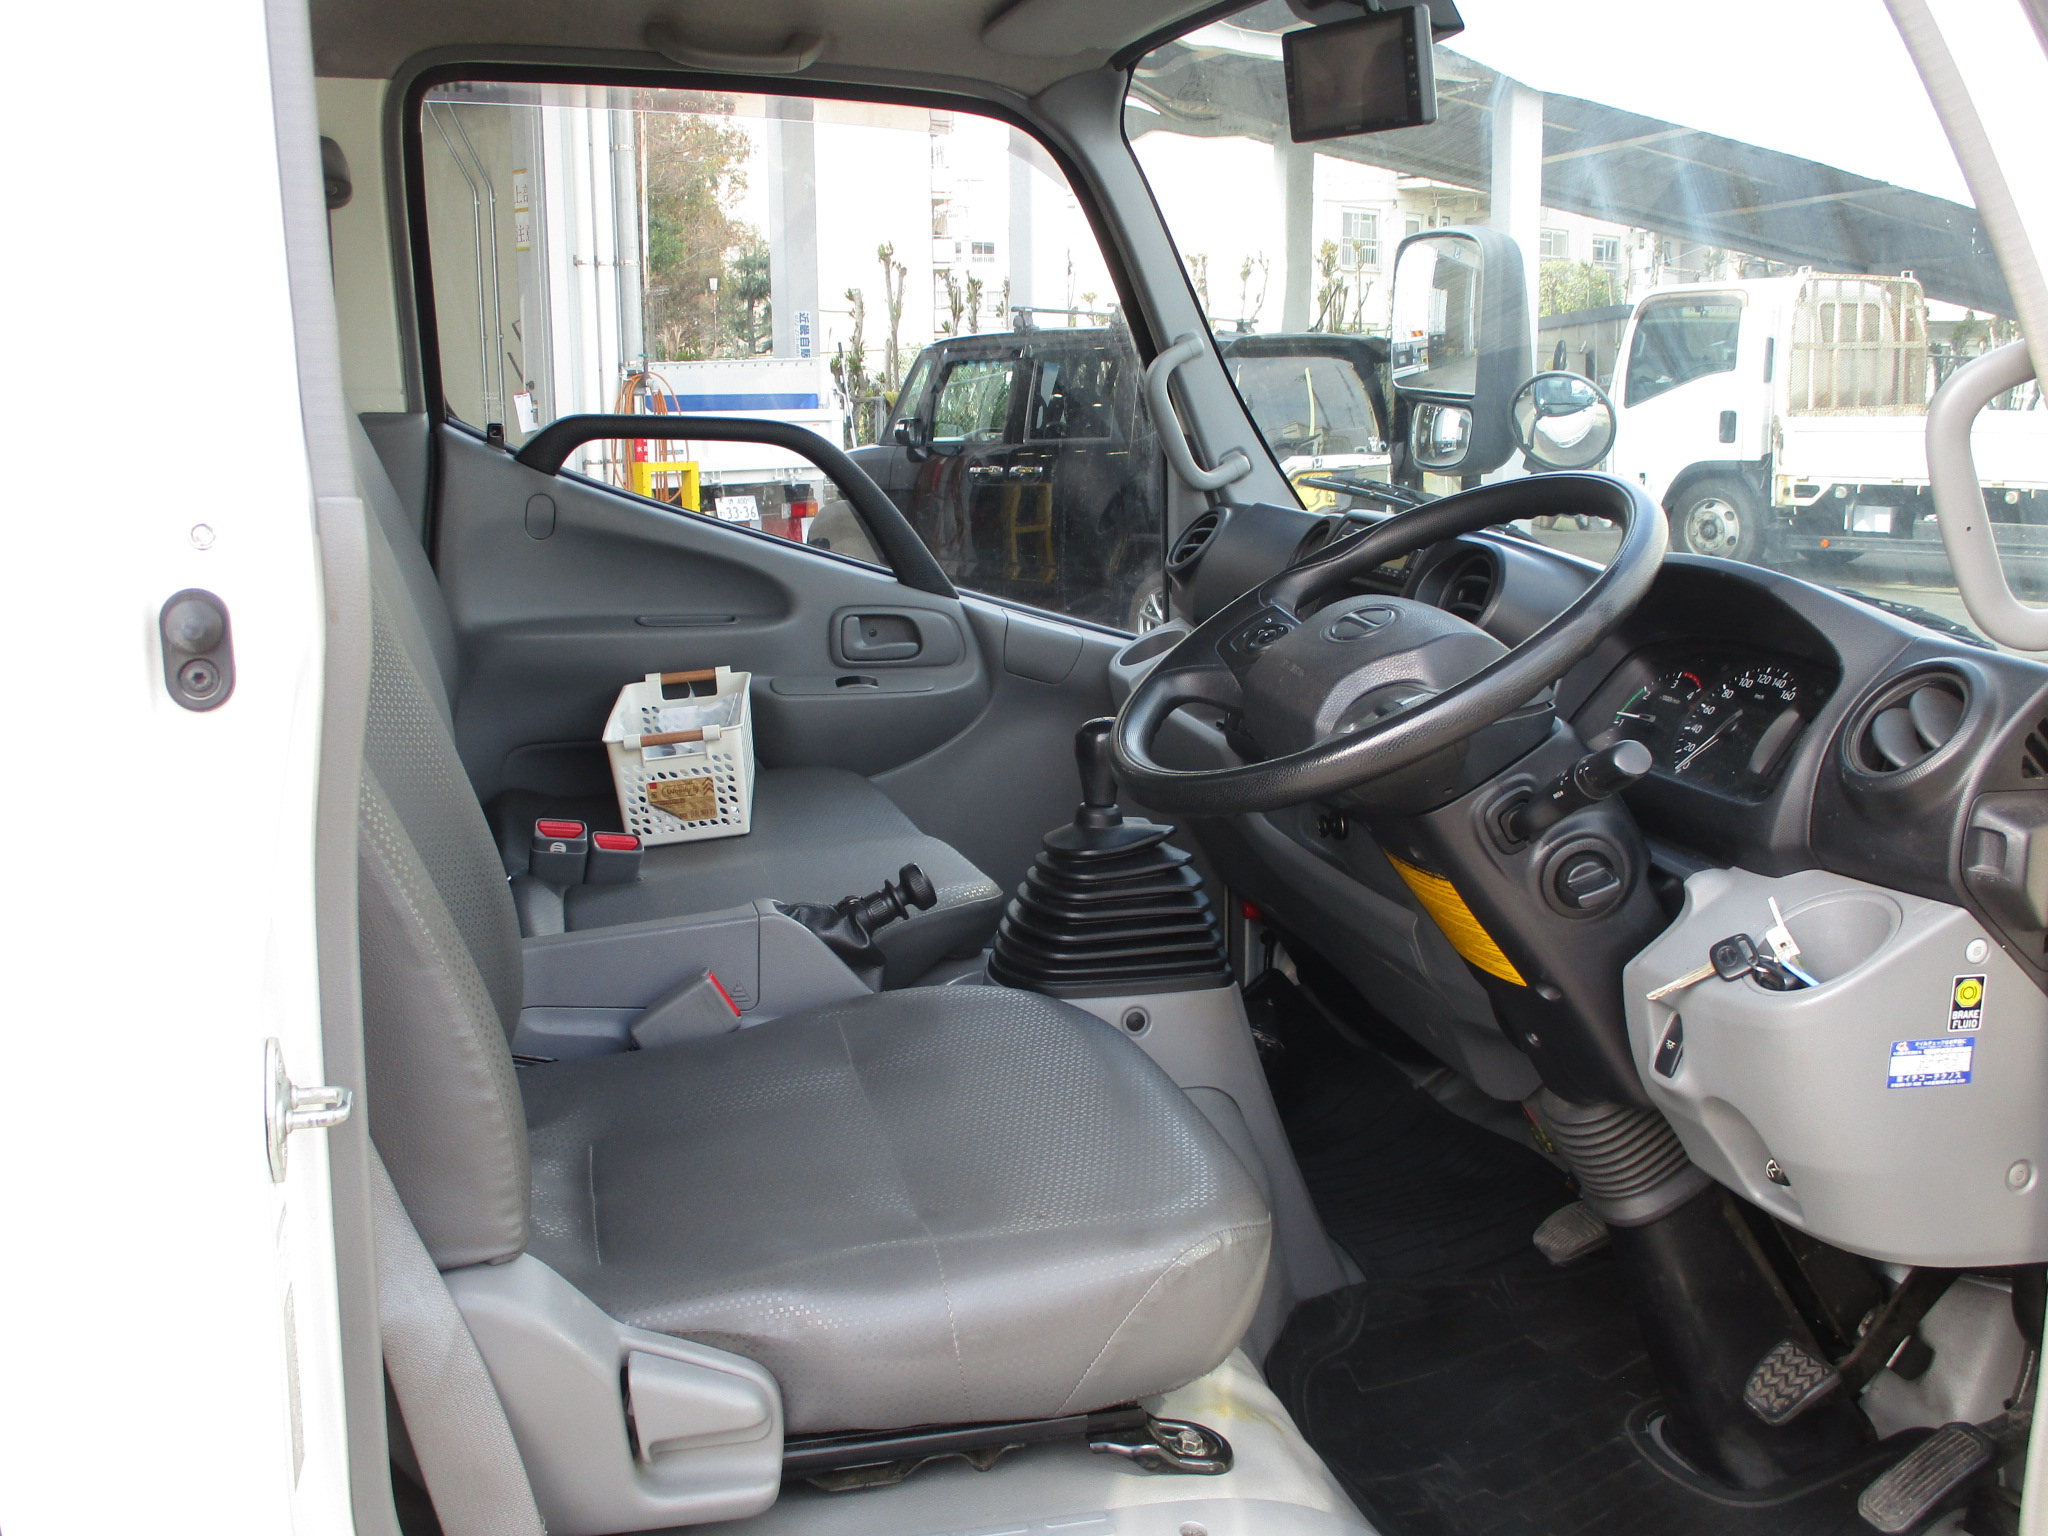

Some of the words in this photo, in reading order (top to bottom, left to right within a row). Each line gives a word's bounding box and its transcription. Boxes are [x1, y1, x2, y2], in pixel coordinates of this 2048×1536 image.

[726, 505, 757, 519] 33-36
[1670, 679, 1679, 689] 3
[1739, 677, 1754, 688] 100
[1757, 674, 1772, 685] 120
[1771, 678, 1787, 689] 140
[1643, 691, 1651, 700] 2
[1687, 691, 1695, 701] 4
[1721, 689, 1734, 699] 80
[1780, 690, 1796, 701] 160
[1703, 706, 1716, 715] 60
[1618, 718, 1625, 727] 1
[1691, 723, 1703, 734] 40
[1683, 742, 1696, 752] 20
[1952, 1010, 1980, 1019] BRAKE
[1952, 1019, 1978, 1029] FLUID
